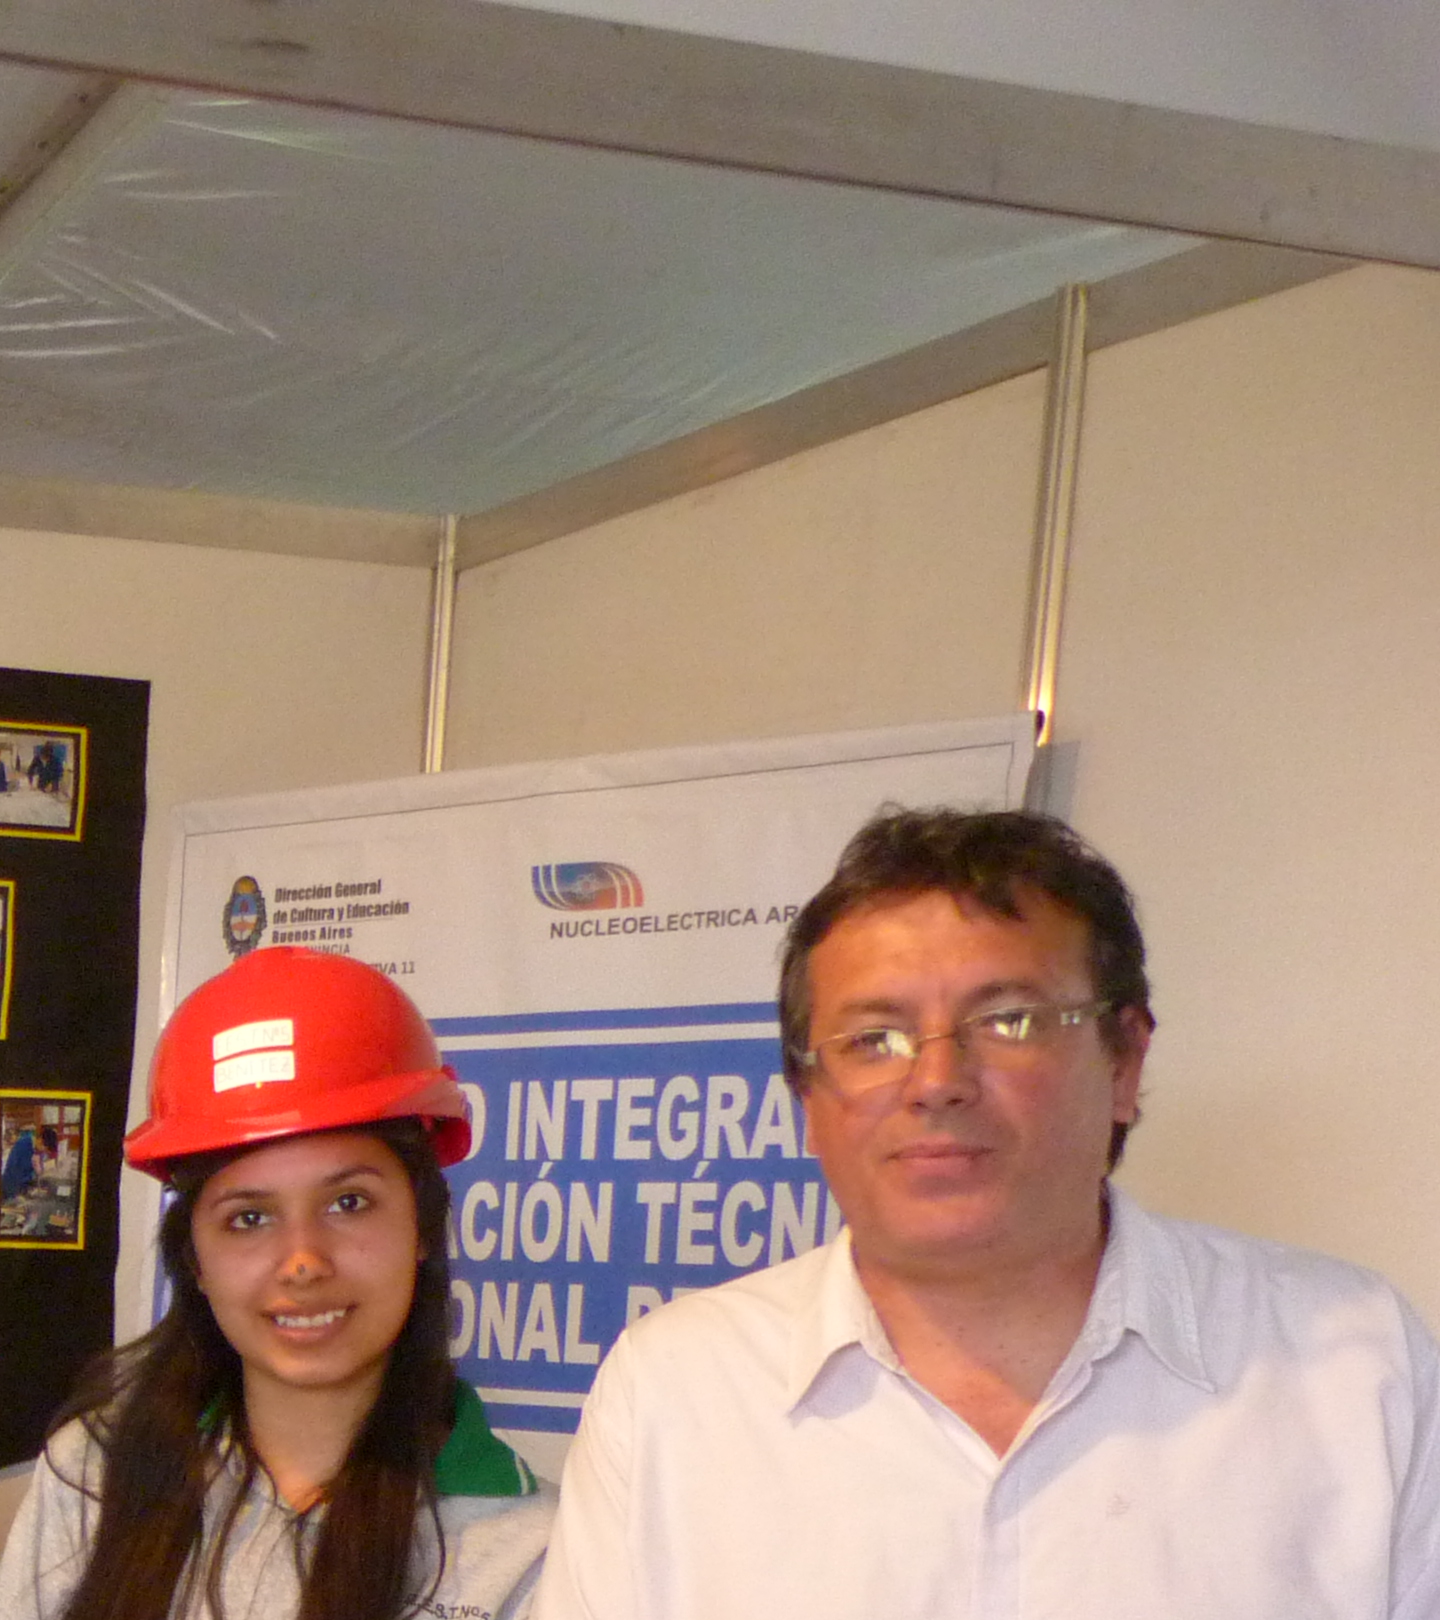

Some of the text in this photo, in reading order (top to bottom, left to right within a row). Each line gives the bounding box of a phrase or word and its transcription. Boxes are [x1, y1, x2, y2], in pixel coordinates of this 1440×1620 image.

[274, 878, 382, 903] Dirección General
[272, 900, 410, 924] de Cultura y Educación
[550, 907, 759, 940] NUCLEOELECTRICA
[272, 925, 353, 944] Buenos Aires
